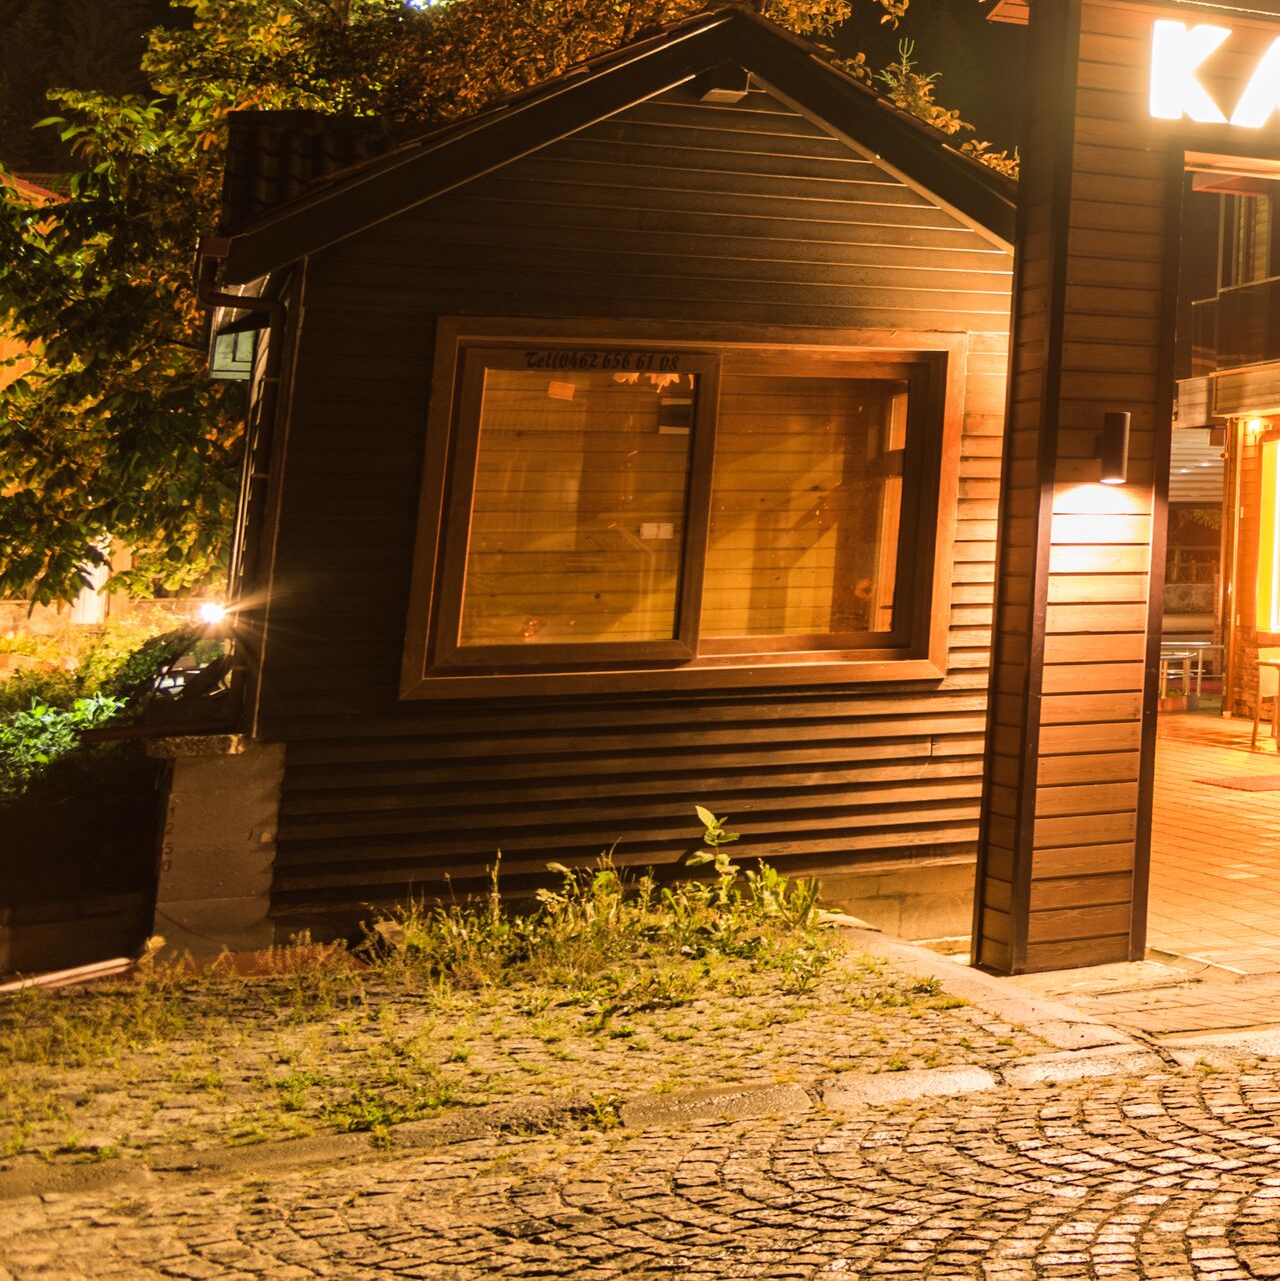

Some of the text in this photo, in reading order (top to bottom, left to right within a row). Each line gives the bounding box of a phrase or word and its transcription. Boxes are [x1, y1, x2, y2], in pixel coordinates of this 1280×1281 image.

[602, 351, 631, 369] 656
[636, 353, 654, 369] 61
[660, 355, 679, 371] 08
